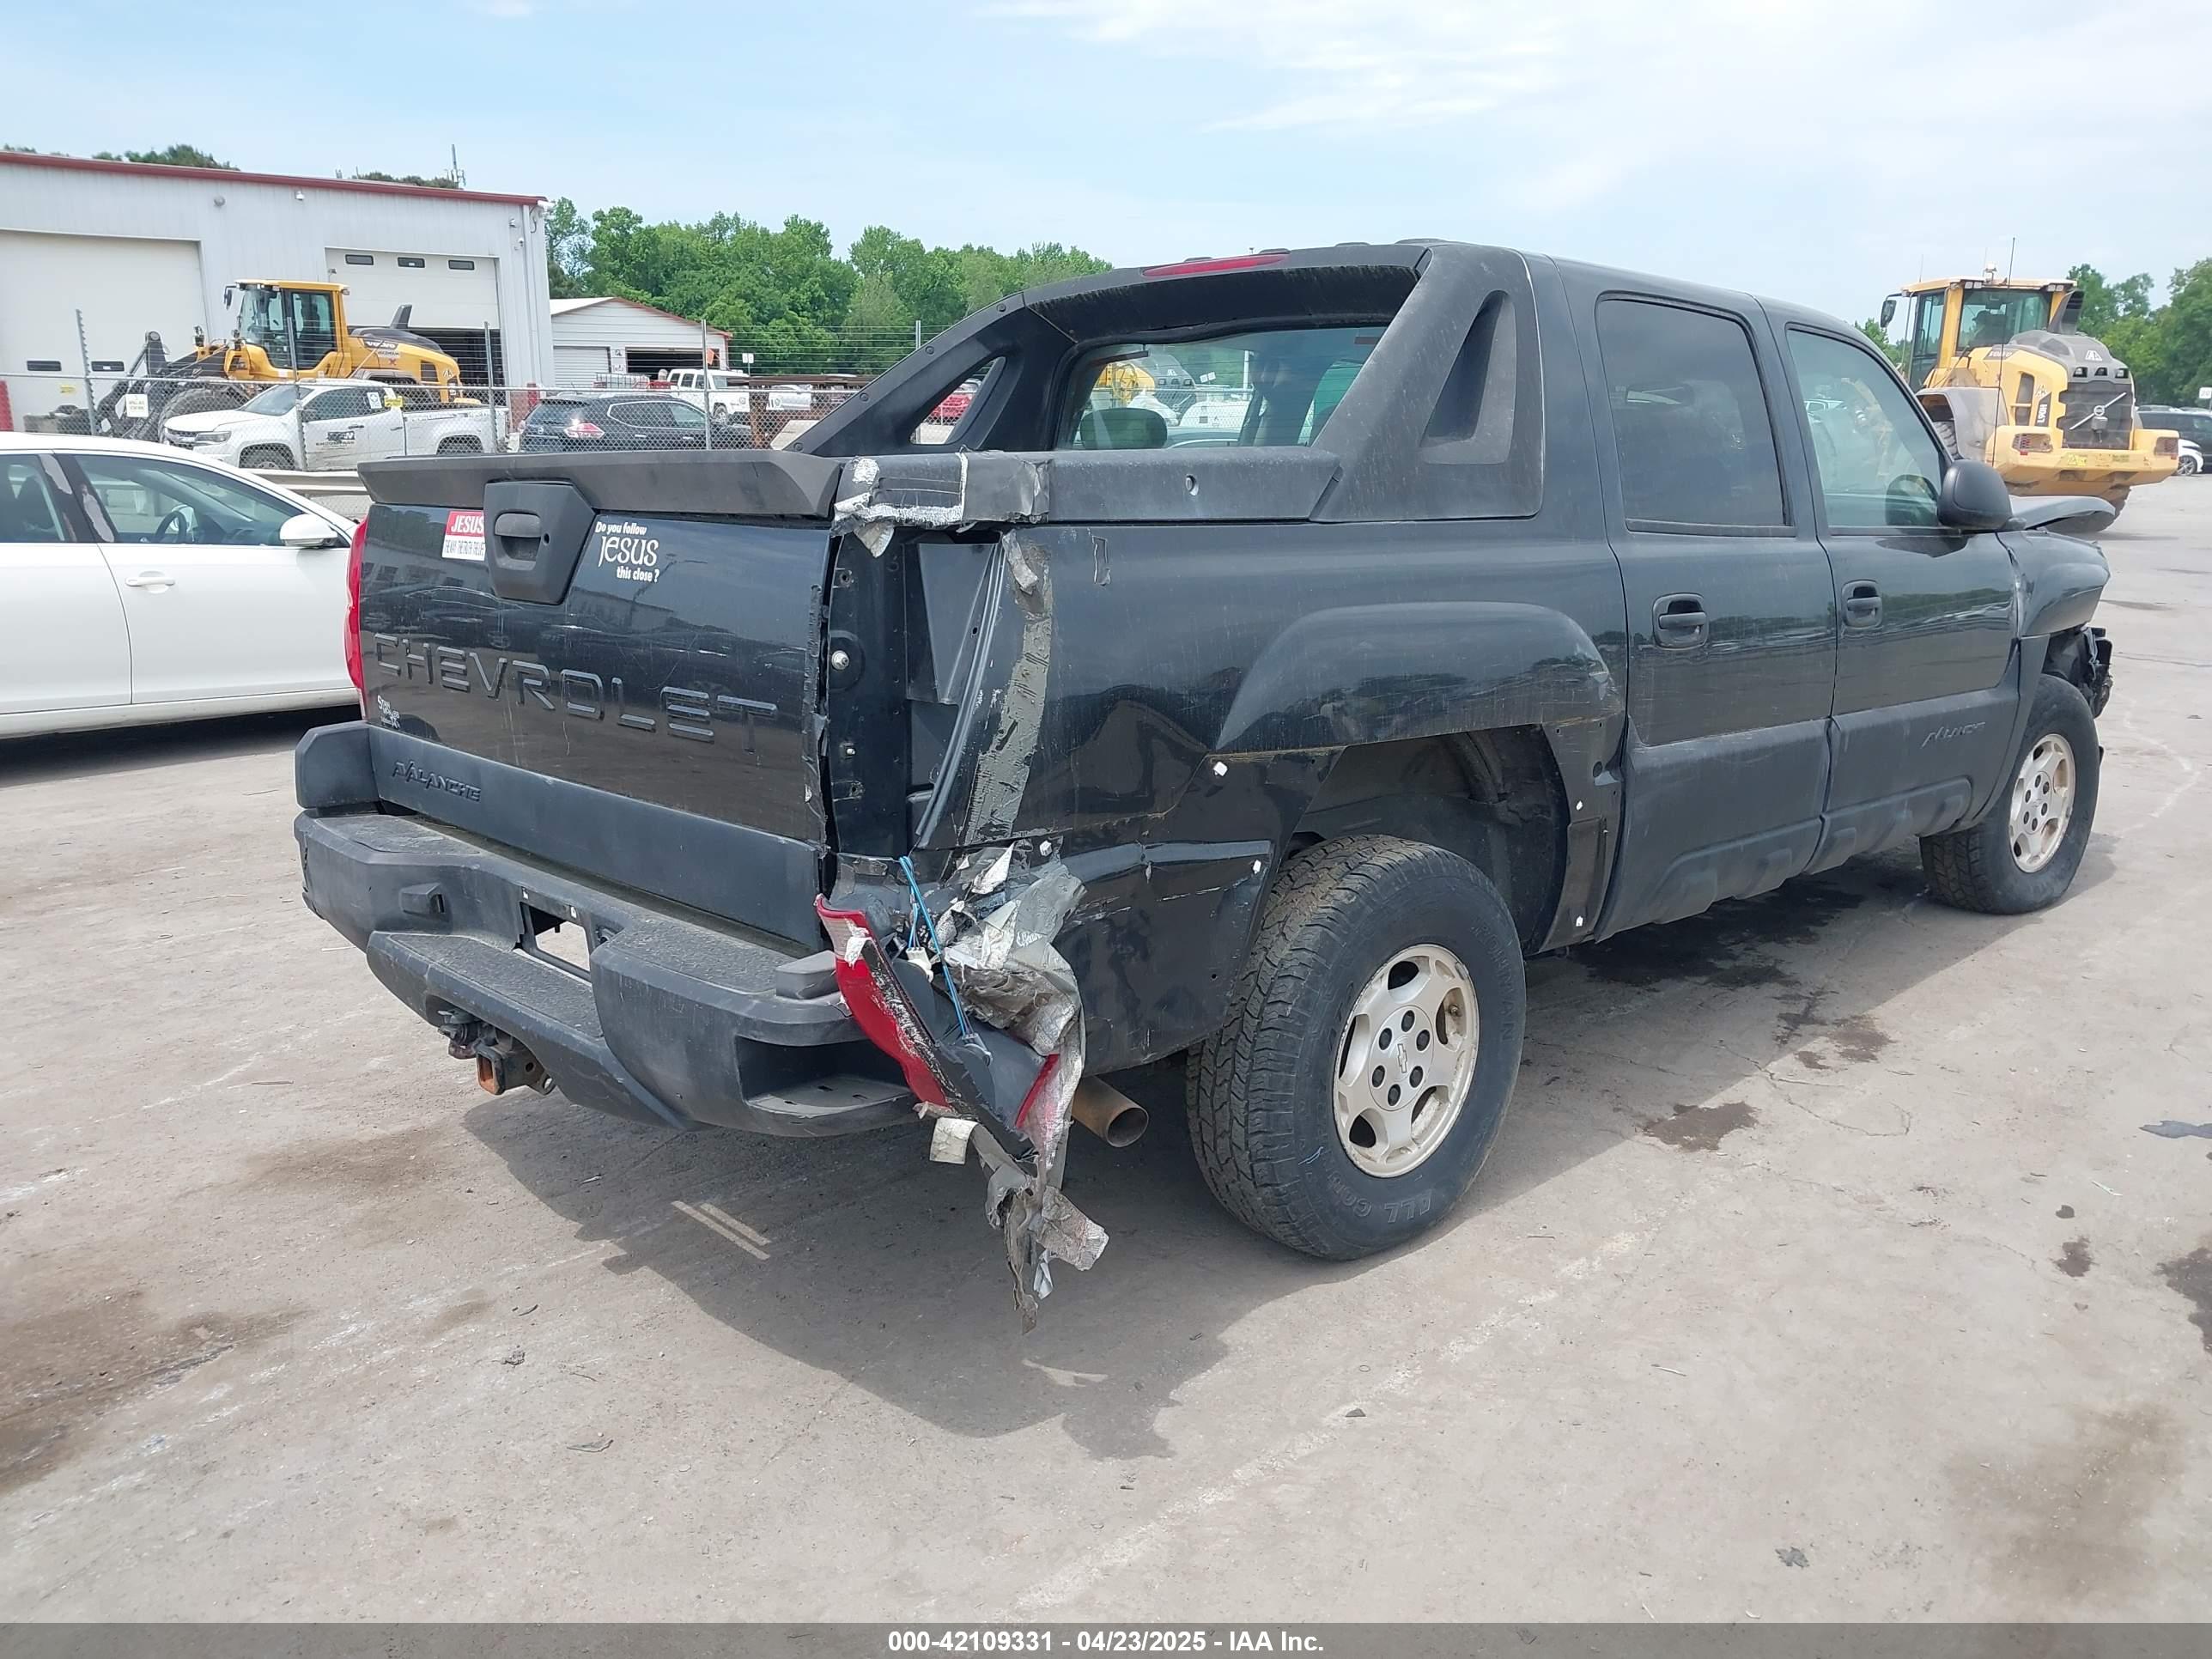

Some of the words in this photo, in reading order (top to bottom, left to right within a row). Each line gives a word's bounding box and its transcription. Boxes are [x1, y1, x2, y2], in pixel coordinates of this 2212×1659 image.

[2037, 404, 2048, 423] L90H
[451, 515, 484, 533] JESUS
[595, 521, 606, 533] Do
[607, 524, 622, 535] you
[623, 522, 647, 536] follow
[617, 566, 631, 580] this
[374, 633, 778, 754] CHEVROLET
[392, 761, 482, 802] AVALANCHE
